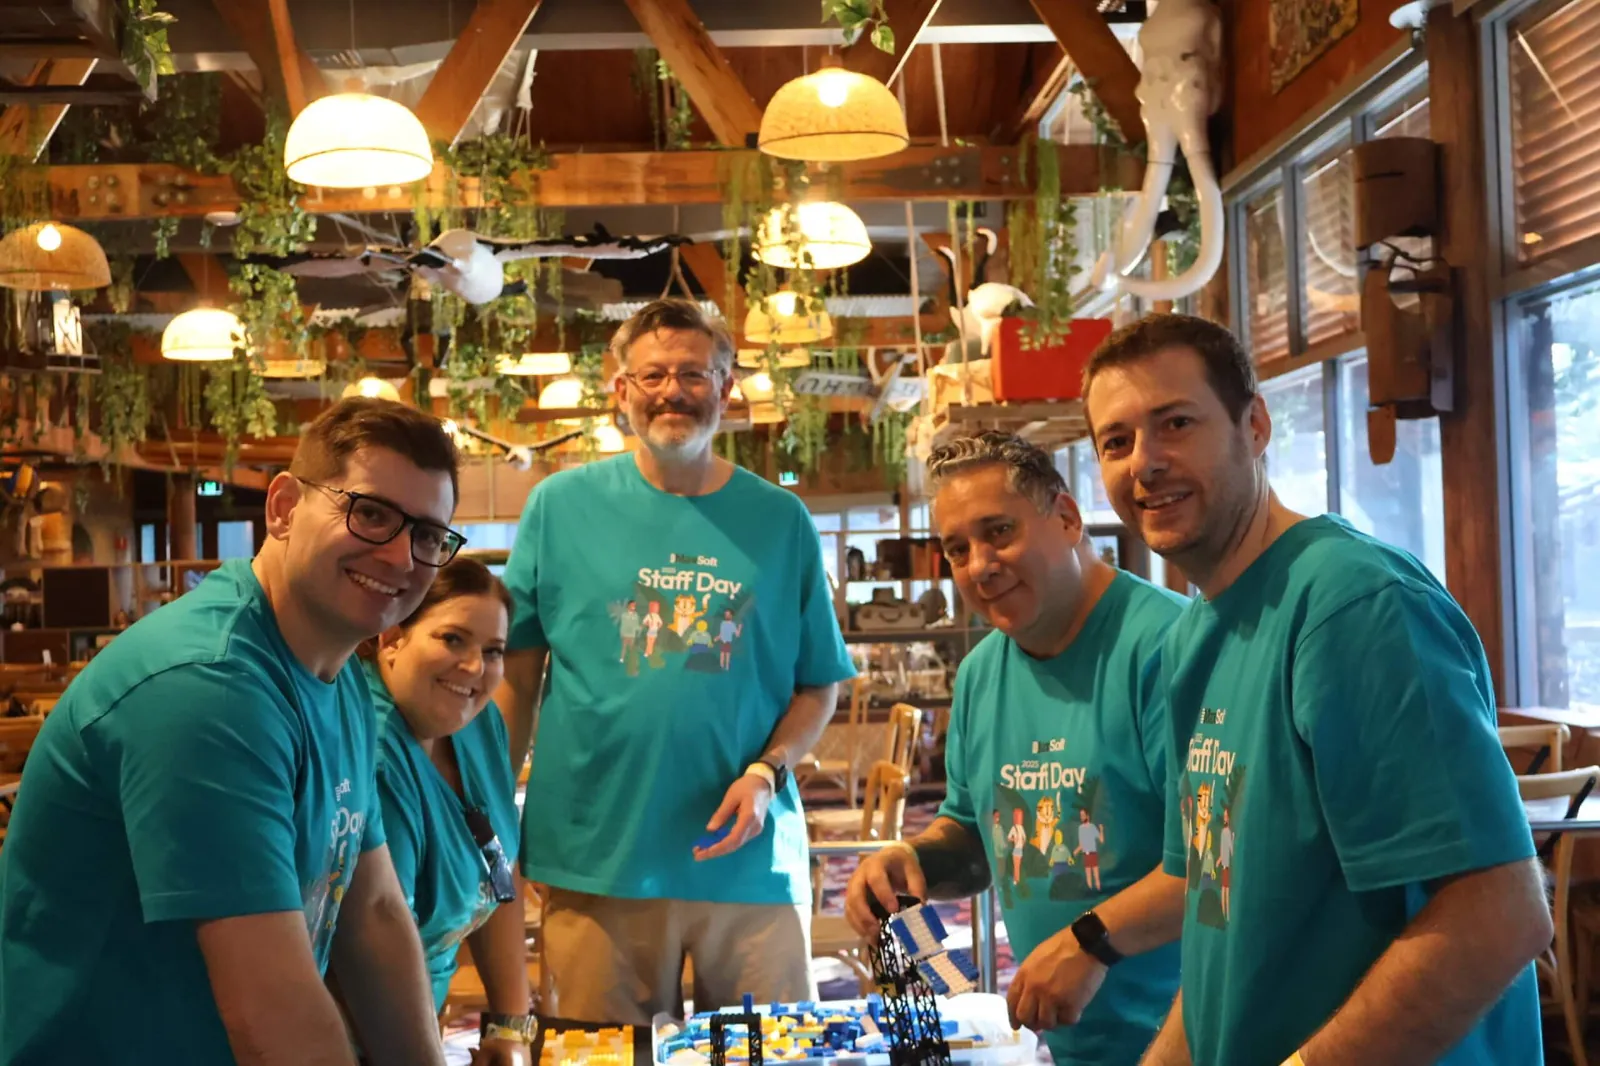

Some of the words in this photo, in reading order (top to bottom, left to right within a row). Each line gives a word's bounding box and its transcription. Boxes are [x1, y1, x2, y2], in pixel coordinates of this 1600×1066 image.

[638, 567, 694, 590] Staff
[696, 572, 742, 600] Day
[1000, 763, 1049, 790] Staff
[1050, 762, 1086, 794] Day
